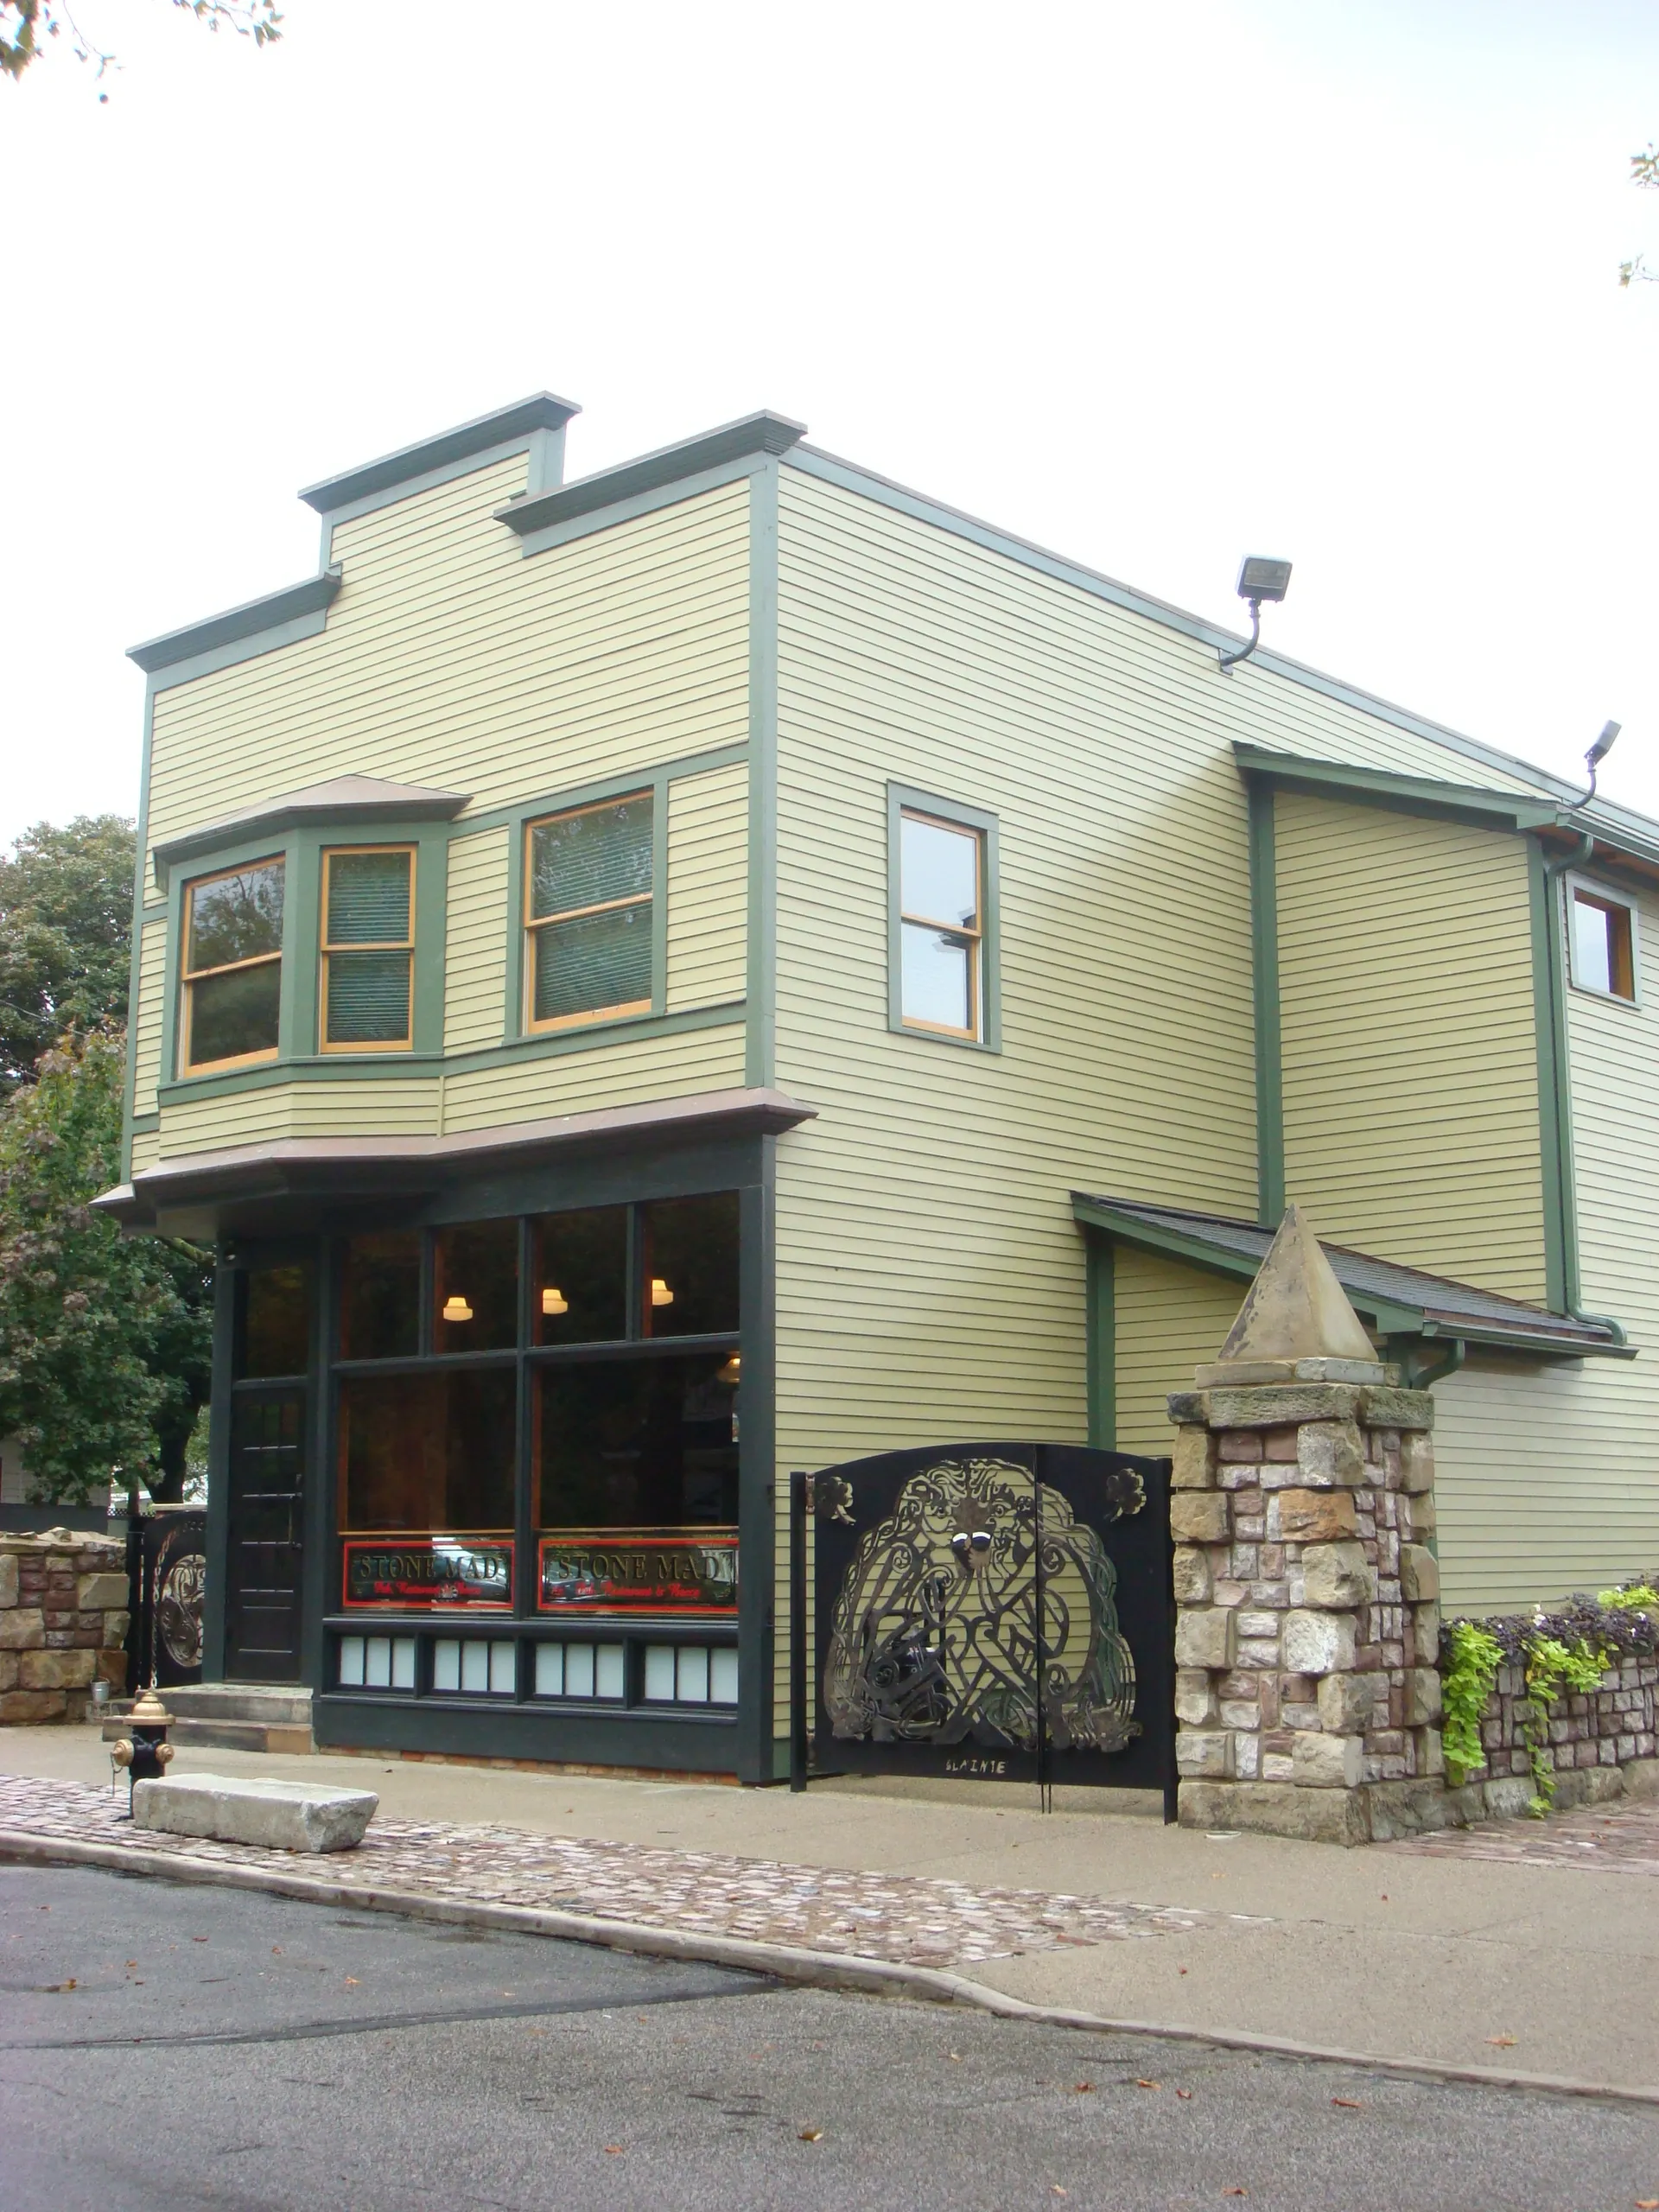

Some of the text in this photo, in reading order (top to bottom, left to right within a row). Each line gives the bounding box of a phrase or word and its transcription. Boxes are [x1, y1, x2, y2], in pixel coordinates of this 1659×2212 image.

[359, 1554, 499, 1580] STONE MAD
[558, 1554, 719, 1580] STONE MAD
